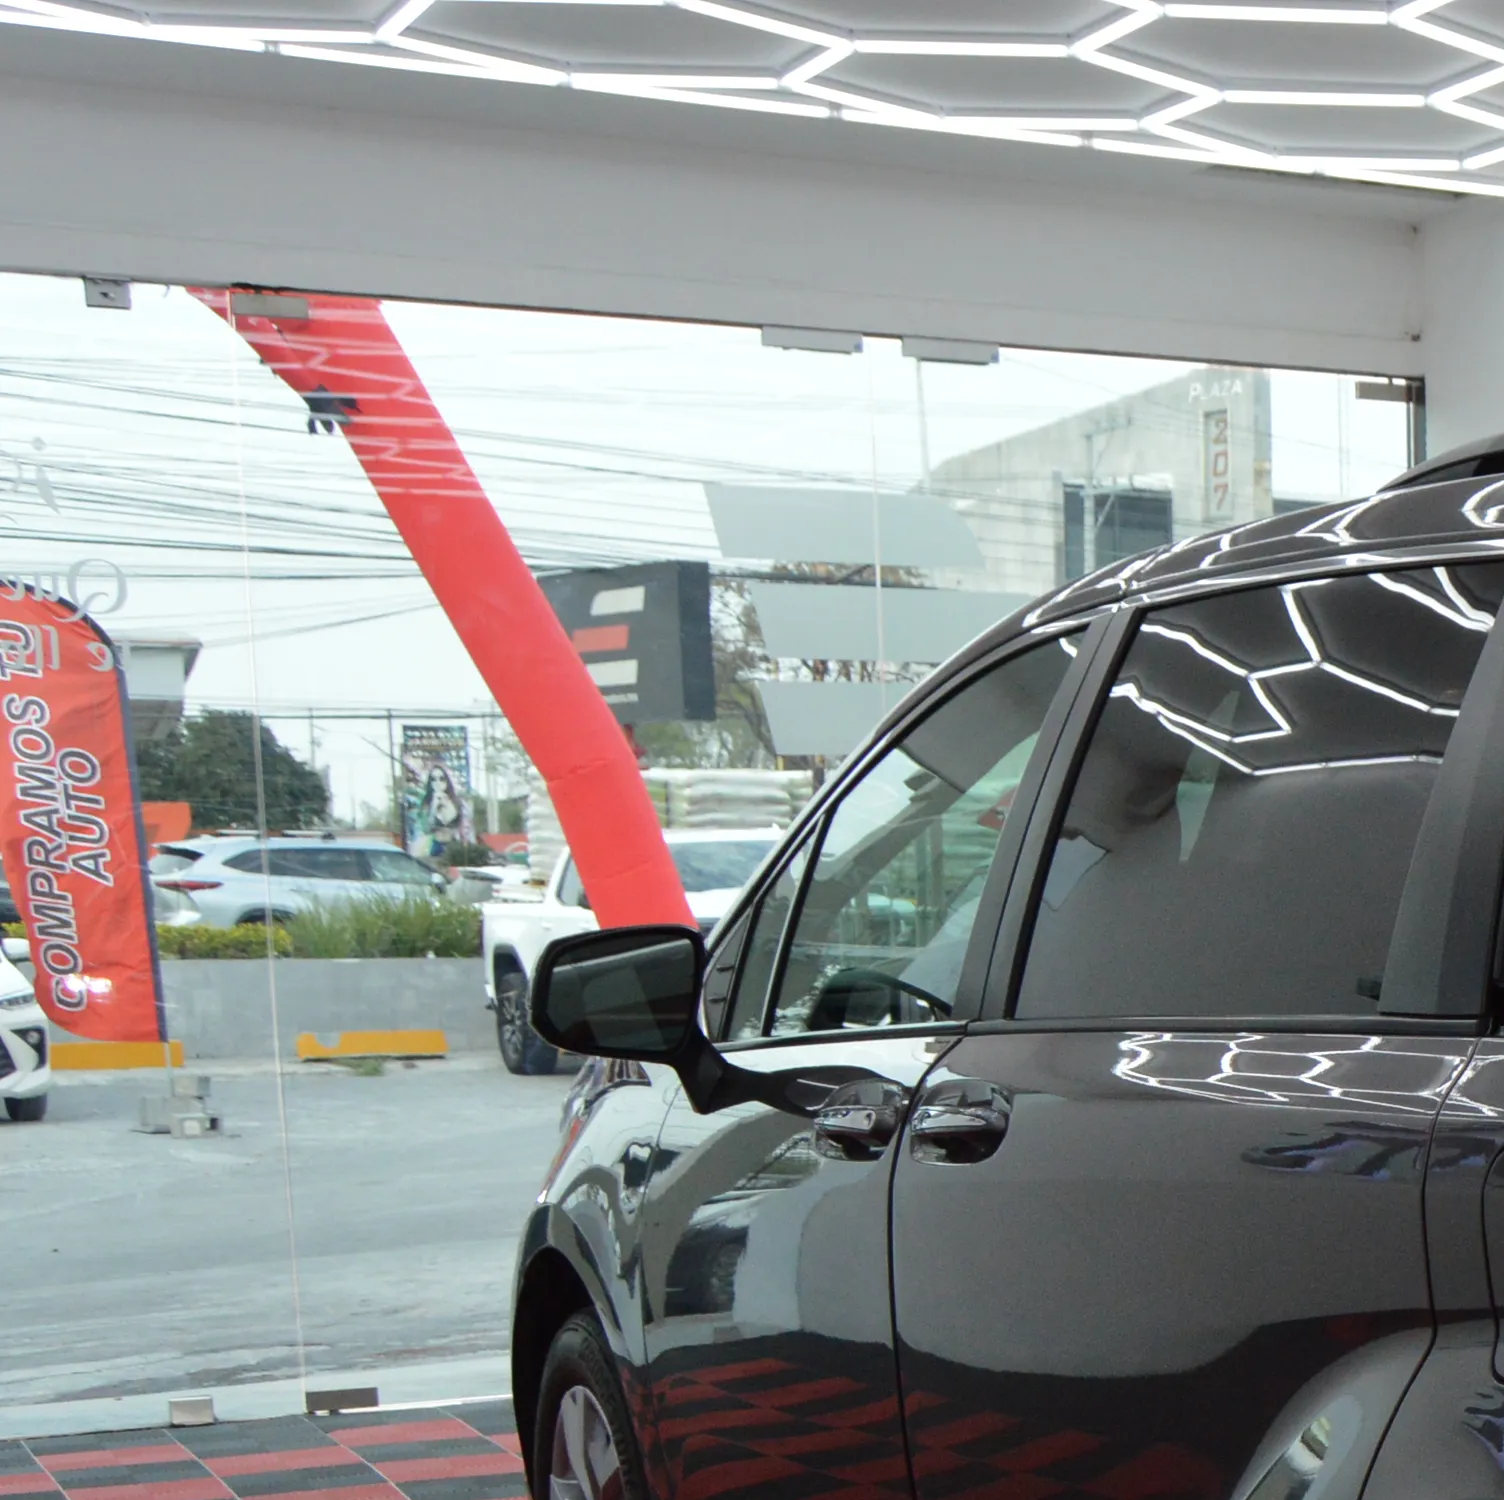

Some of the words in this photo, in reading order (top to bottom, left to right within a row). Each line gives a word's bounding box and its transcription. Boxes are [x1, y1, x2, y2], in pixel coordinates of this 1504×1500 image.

[1189, 379, 1243, 402] PLAZA
[1213, 417, 1229, 511] 207
[5, 693, 86, 1011] COMPRAMOS
[56, 747, 114, 887] AUTO
